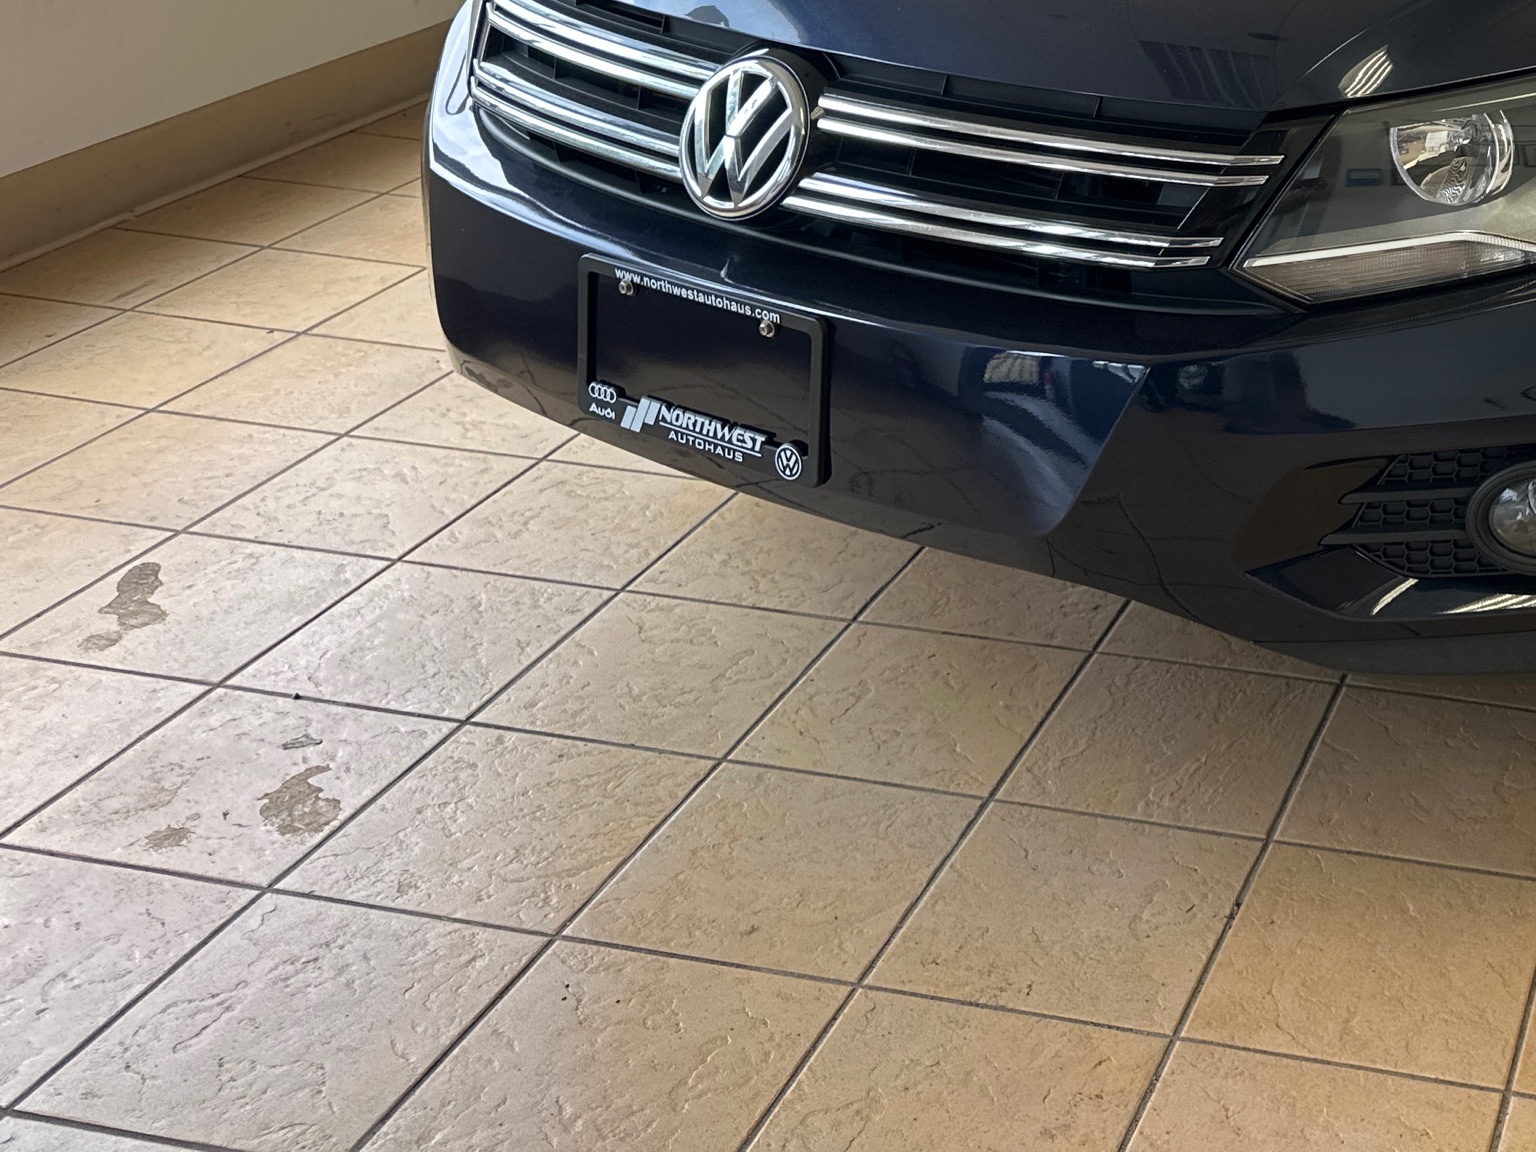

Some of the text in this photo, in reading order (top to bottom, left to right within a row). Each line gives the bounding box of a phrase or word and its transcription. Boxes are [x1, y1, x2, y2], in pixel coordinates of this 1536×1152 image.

[615, 268, 780, 323] www.northwestautohaus.com
[659, 404, 766, 452] NORTHWEST
[668, 430, 743, 462] AUTOHAUS
